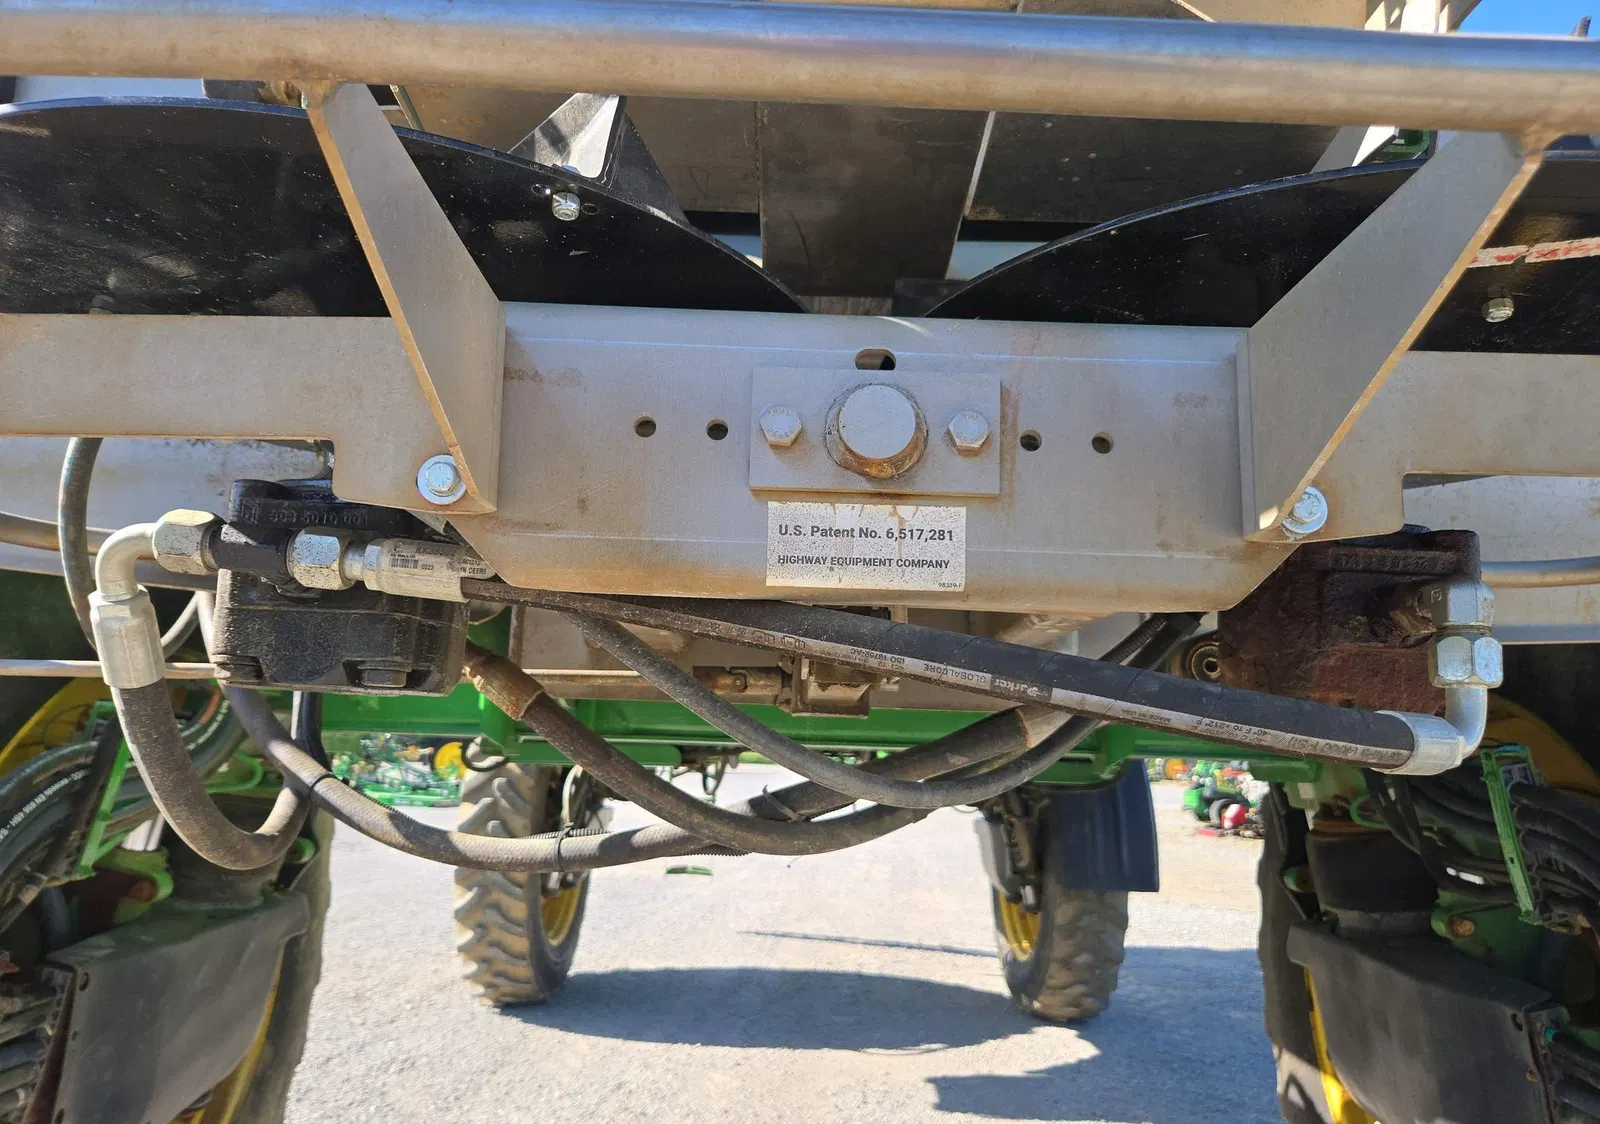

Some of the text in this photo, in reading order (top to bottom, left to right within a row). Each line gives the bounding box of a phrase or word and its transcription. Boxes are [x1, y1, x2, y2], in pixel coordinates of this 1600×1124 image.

[778, 524, 954, 543] U.S. Patent No. 6,517,281
[777, 554, 950, 569] HIGHWAY EQUIPMENT COMPANY
[992, 677, 1038, 696] Parker
